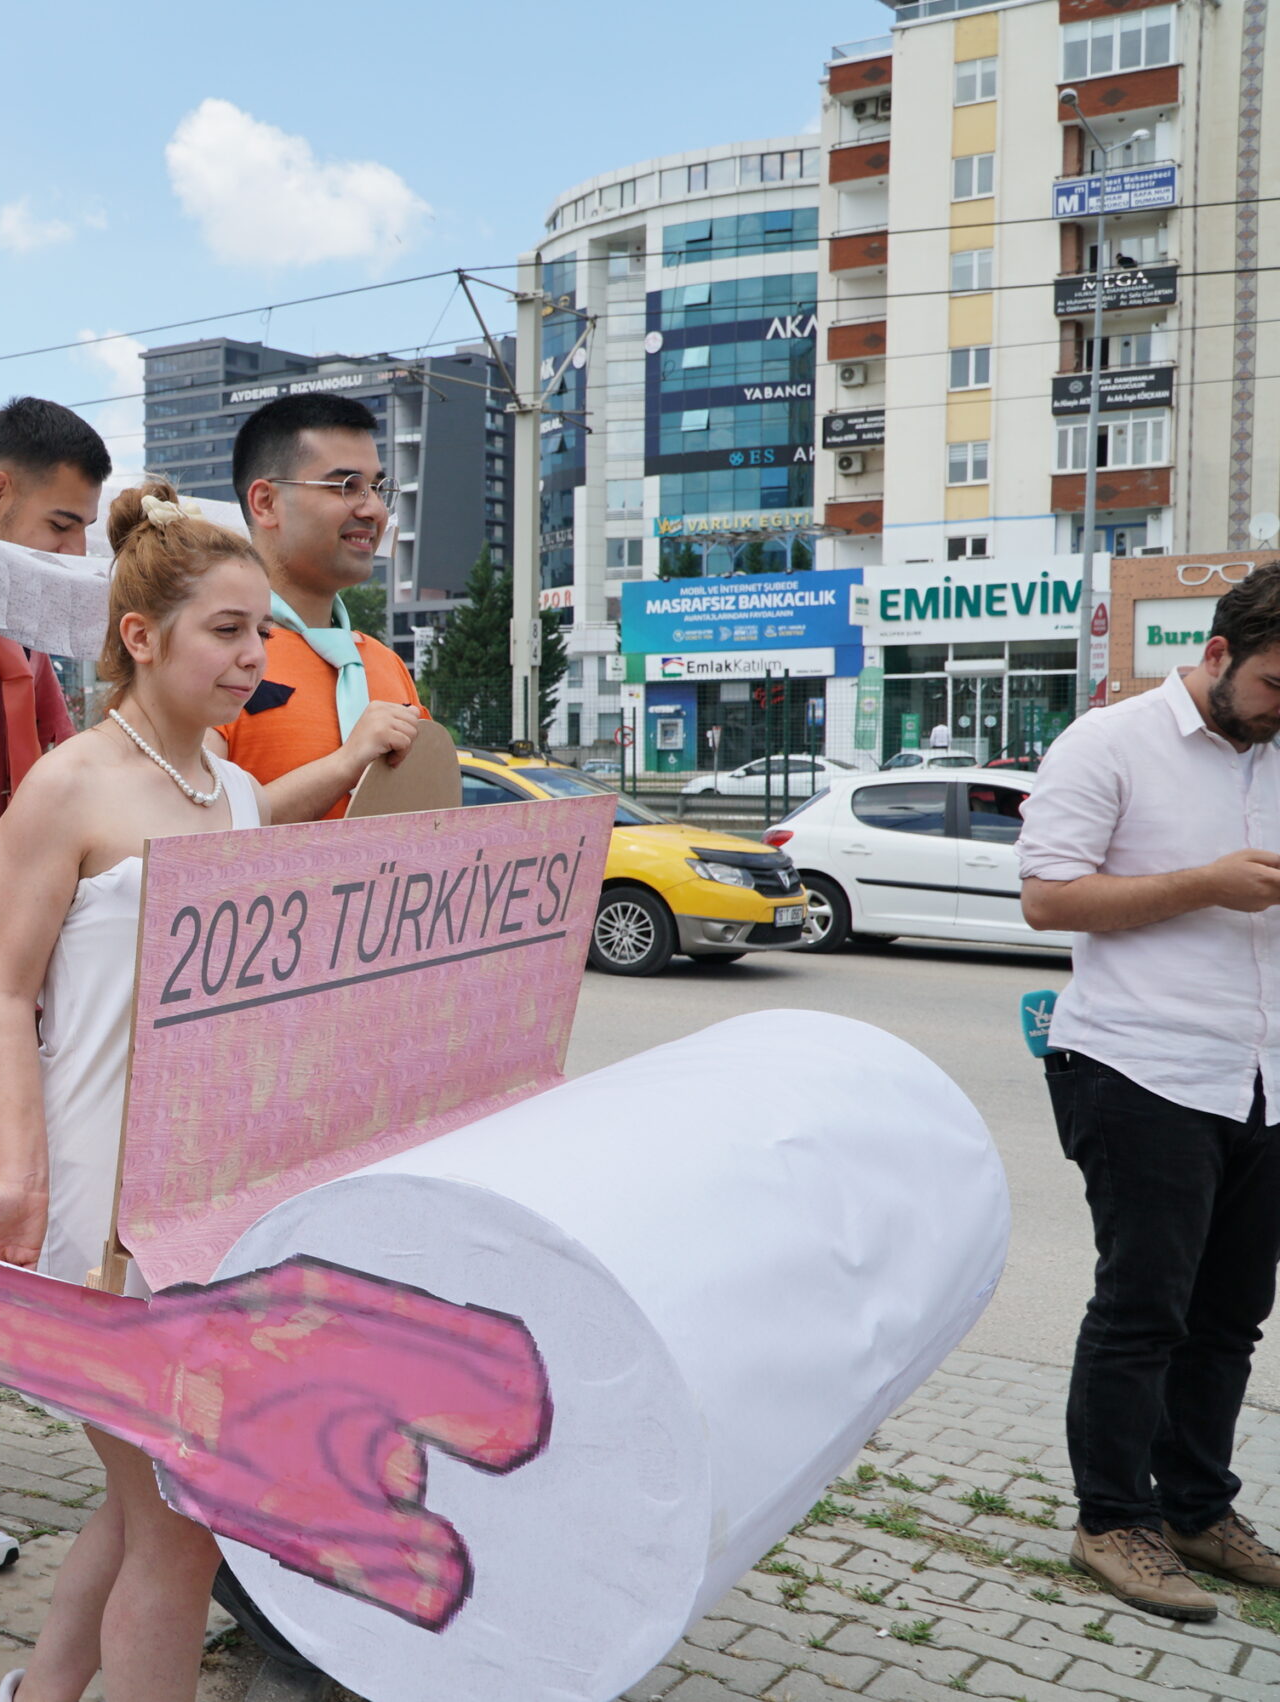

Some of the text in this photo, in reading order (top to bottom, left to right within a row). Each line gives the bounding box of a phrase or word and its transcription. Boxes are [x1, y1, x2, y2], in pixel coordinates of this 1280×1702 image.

[1123, 170, 1172, 183] Muhasebeci
[289, 374, 363, 396] RIZVANOĞLU
[743, 383, 812, 401] YABANCI
[749, 448, 776, 465] ES
[687, 516, 754, 532] VARLIK
[680, 580, 799, 596] MOBİL VE İNTERNET ŞUBEDE
[880, 571, 1084, 622] EMİNEVİM
[646, 595, 737, 615] MASRAFSIZ
[738, 590, 836, 610] BANKACILIK
[684, 611, 749, 623] AVANTAJLARINDAN
[1147, 624, 1211, 646] Burs
[159, 836, 586, 1005] 2023 TÜRKİYE'Sİ
